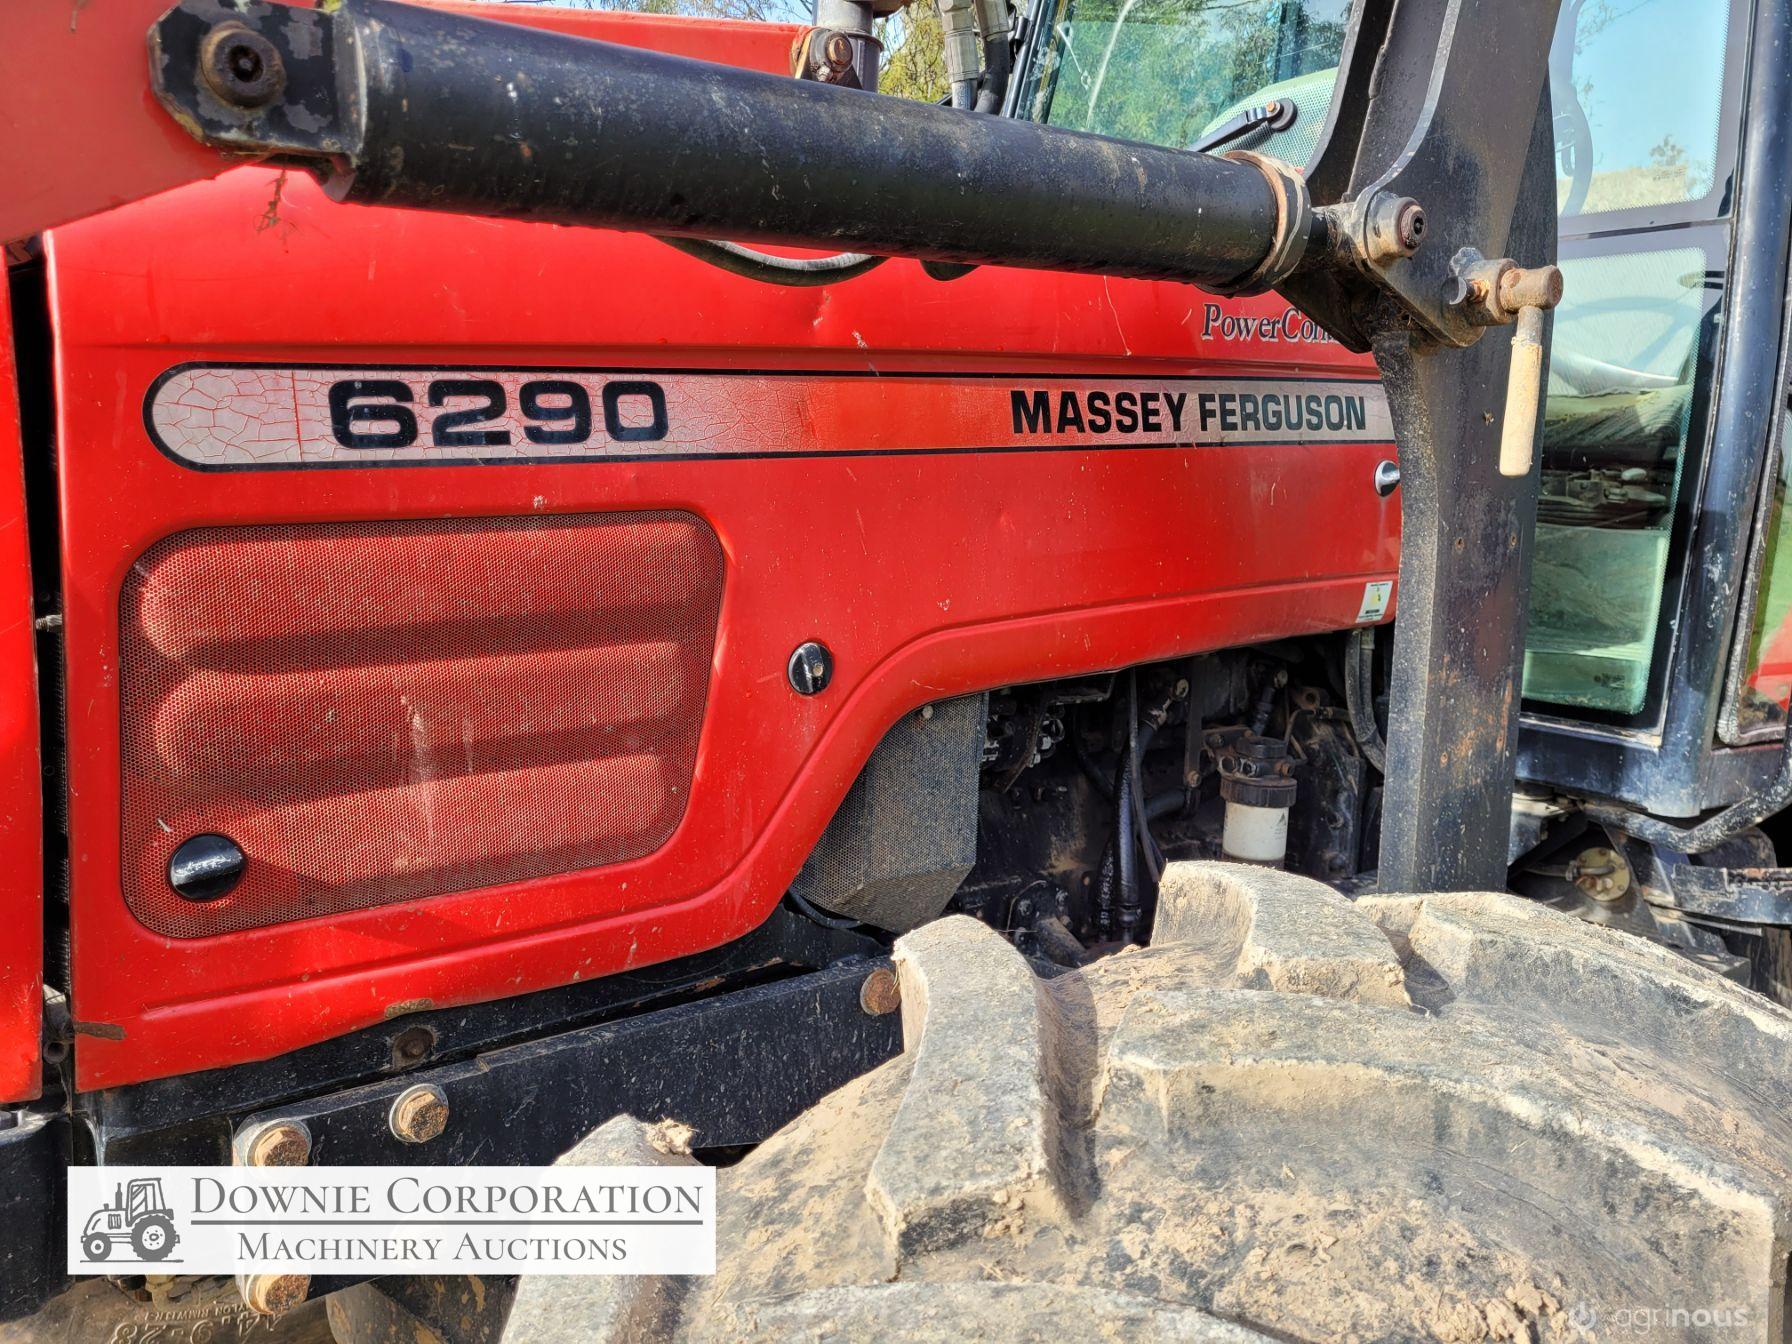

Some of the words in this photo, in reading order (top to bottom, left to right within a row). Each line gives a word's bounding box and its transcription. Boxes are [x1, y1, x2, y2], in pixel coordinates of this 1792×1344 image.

[1201, 302, 1338, 344] PowerCon
[328, 380, 669, 449] 6290
[1010, 390, 1188, 434] MASSEY
[1198, 393, 1366, 431] FERGUSON
